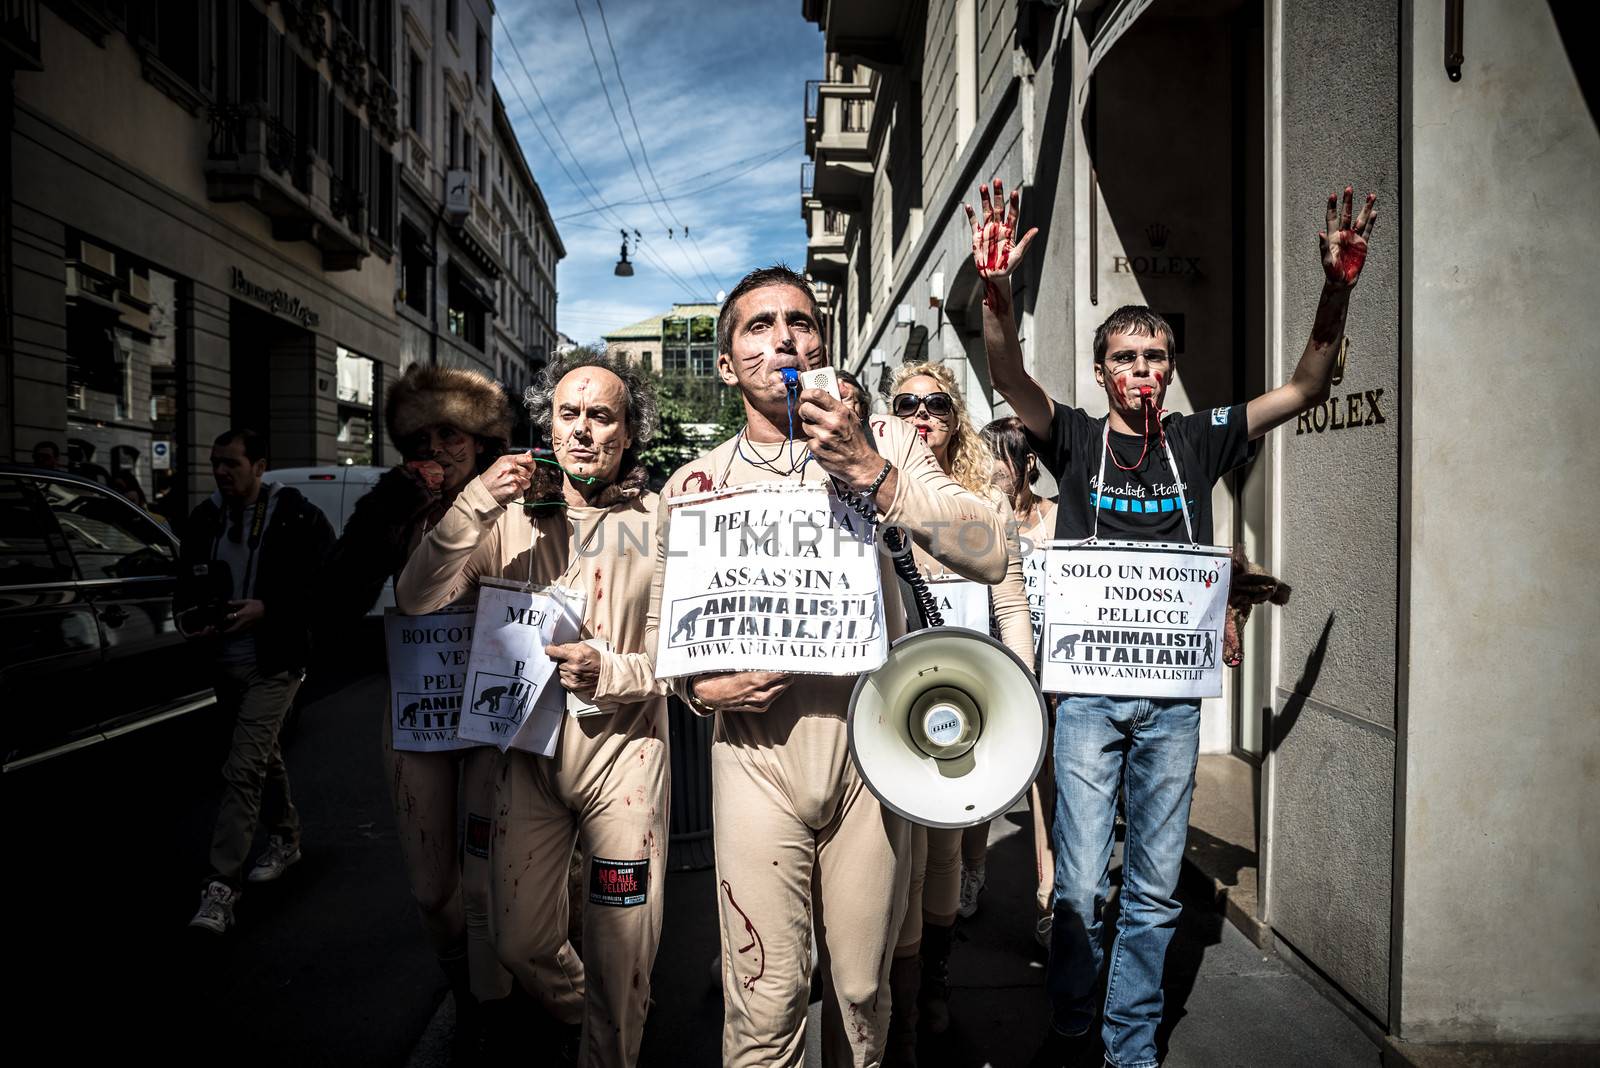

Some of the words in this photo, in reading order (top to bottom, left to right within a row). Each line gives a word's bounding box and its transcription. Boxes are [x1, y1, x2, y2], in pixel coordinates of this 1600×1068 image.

[1113, 256, 1203, 275] ROLEX
[1296, 389, 1386, 435] ROLEX
[739, 537, 821, 559] MOA
[708, 567, 850, 590] ASSASSINA
[1061, 563, 1112, 579] SOLO
[1118, 565, 1146, 580] UN
[1149, 566, 1219, 584] MOSTRO
[1104, 586, 1185, 603] INDOSSA
[703, 596, 866, 616] ANIMALISTI
[1097, 607, 1190, 625] PELLICCE
[706, 616, 859, 640] ITALIANI
[1081, 629, 1201, 647] ANIMALISTI
[437, 650, 470, 667] VE
[687, 641, 869, 660] WWW.ANIMALISTIIT
[1084, 646, 1198, 666] ITALIANI
[1071, 665, 1204, 681] WWW.ANIMALISTI.IT
[598, 868, 617, 884] NO
[618, 873, 634, 882] ALLE
[603, 881, 638, 892] PELLICCE
